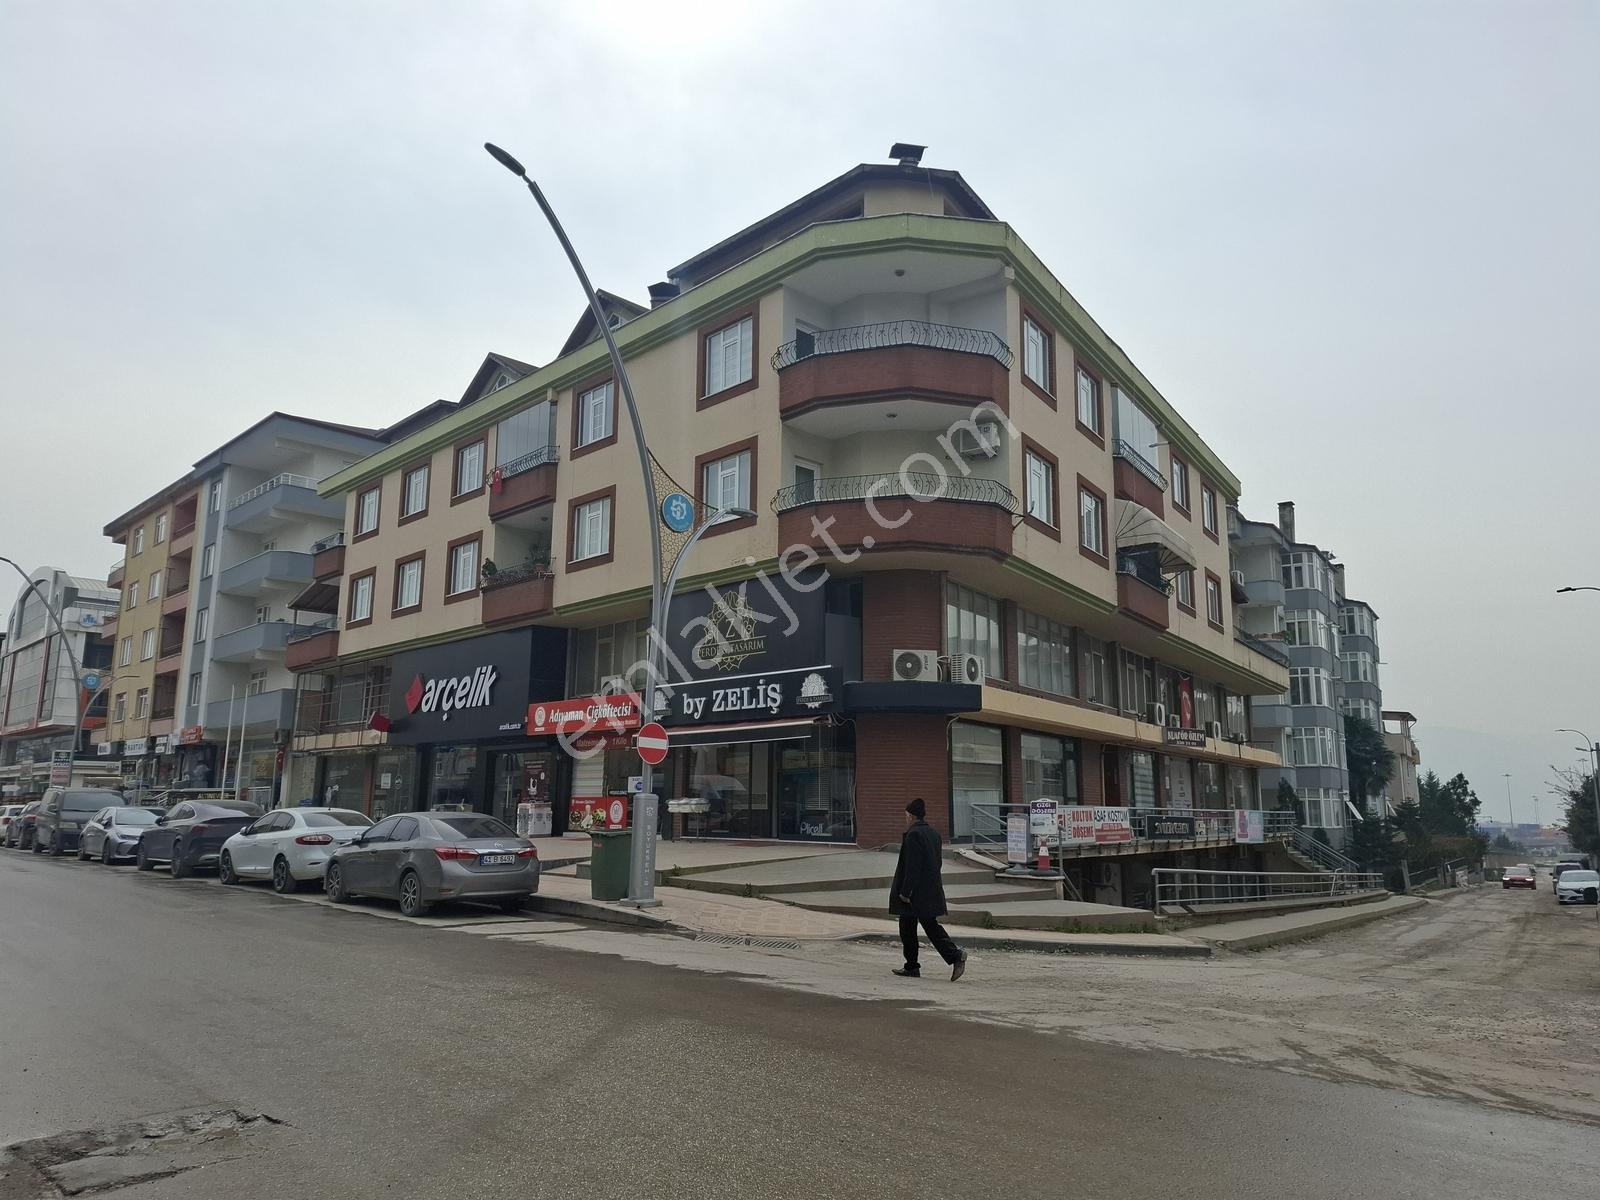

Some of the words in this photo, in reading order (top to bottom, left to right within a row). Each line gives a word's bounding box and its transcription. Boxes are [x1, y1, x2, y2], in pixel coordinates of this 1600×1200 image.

[421, 665, 497, 721] arçelik
[683, 693, 706, 719] by
[712, 679, 783, 714] ZELİŞ
[1072, 811, 1093, 822] KOLTUK
[1073, 826, 1095, 841] DÖŞEME
